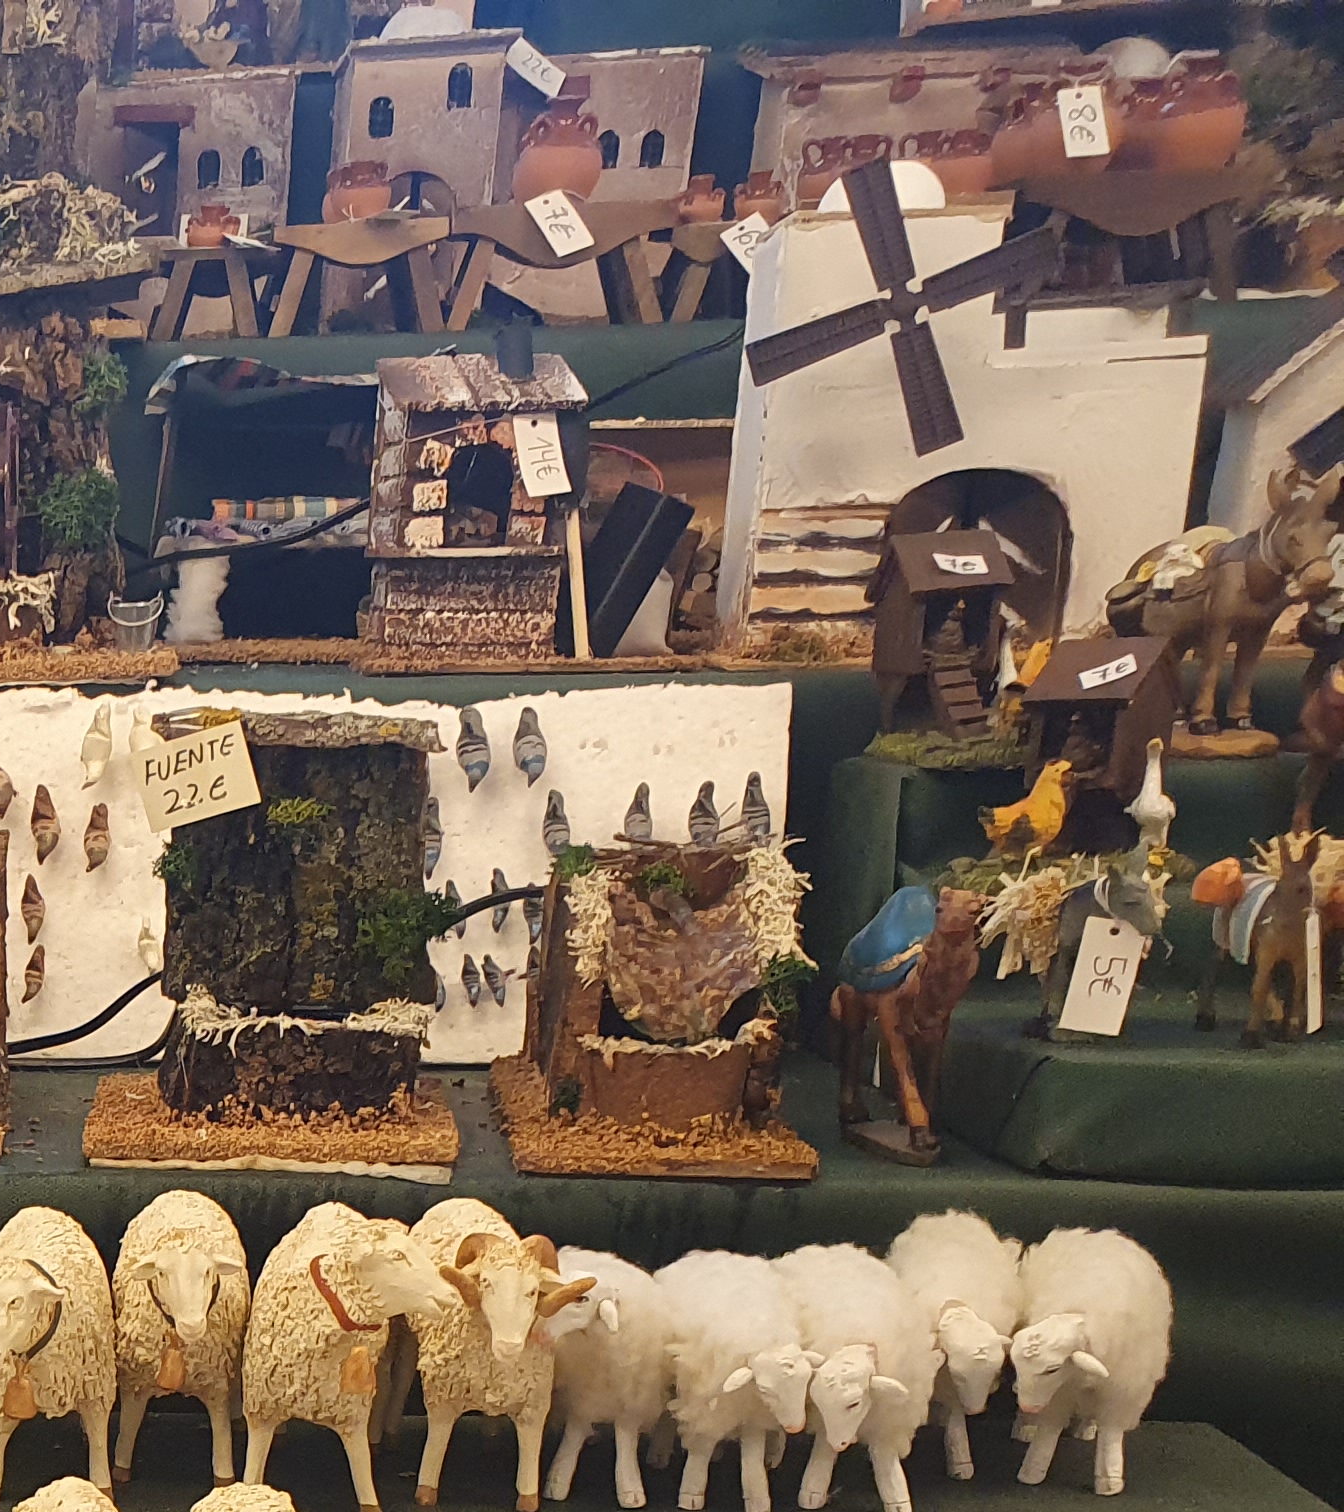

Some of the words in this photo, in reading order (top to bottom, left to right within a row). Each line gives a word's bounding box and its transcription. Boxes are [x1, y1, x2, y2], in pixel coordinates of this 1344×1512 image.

[521, 52, 553, 84] 22€
[1067, 103, 1097, 144] 8€
[544, 206, 576, 240] 7€
[527, 435, 561, 481] 14€
[144, 733, 235, 787] FUENTE
[1087, 955, 1130, 998] 5€
